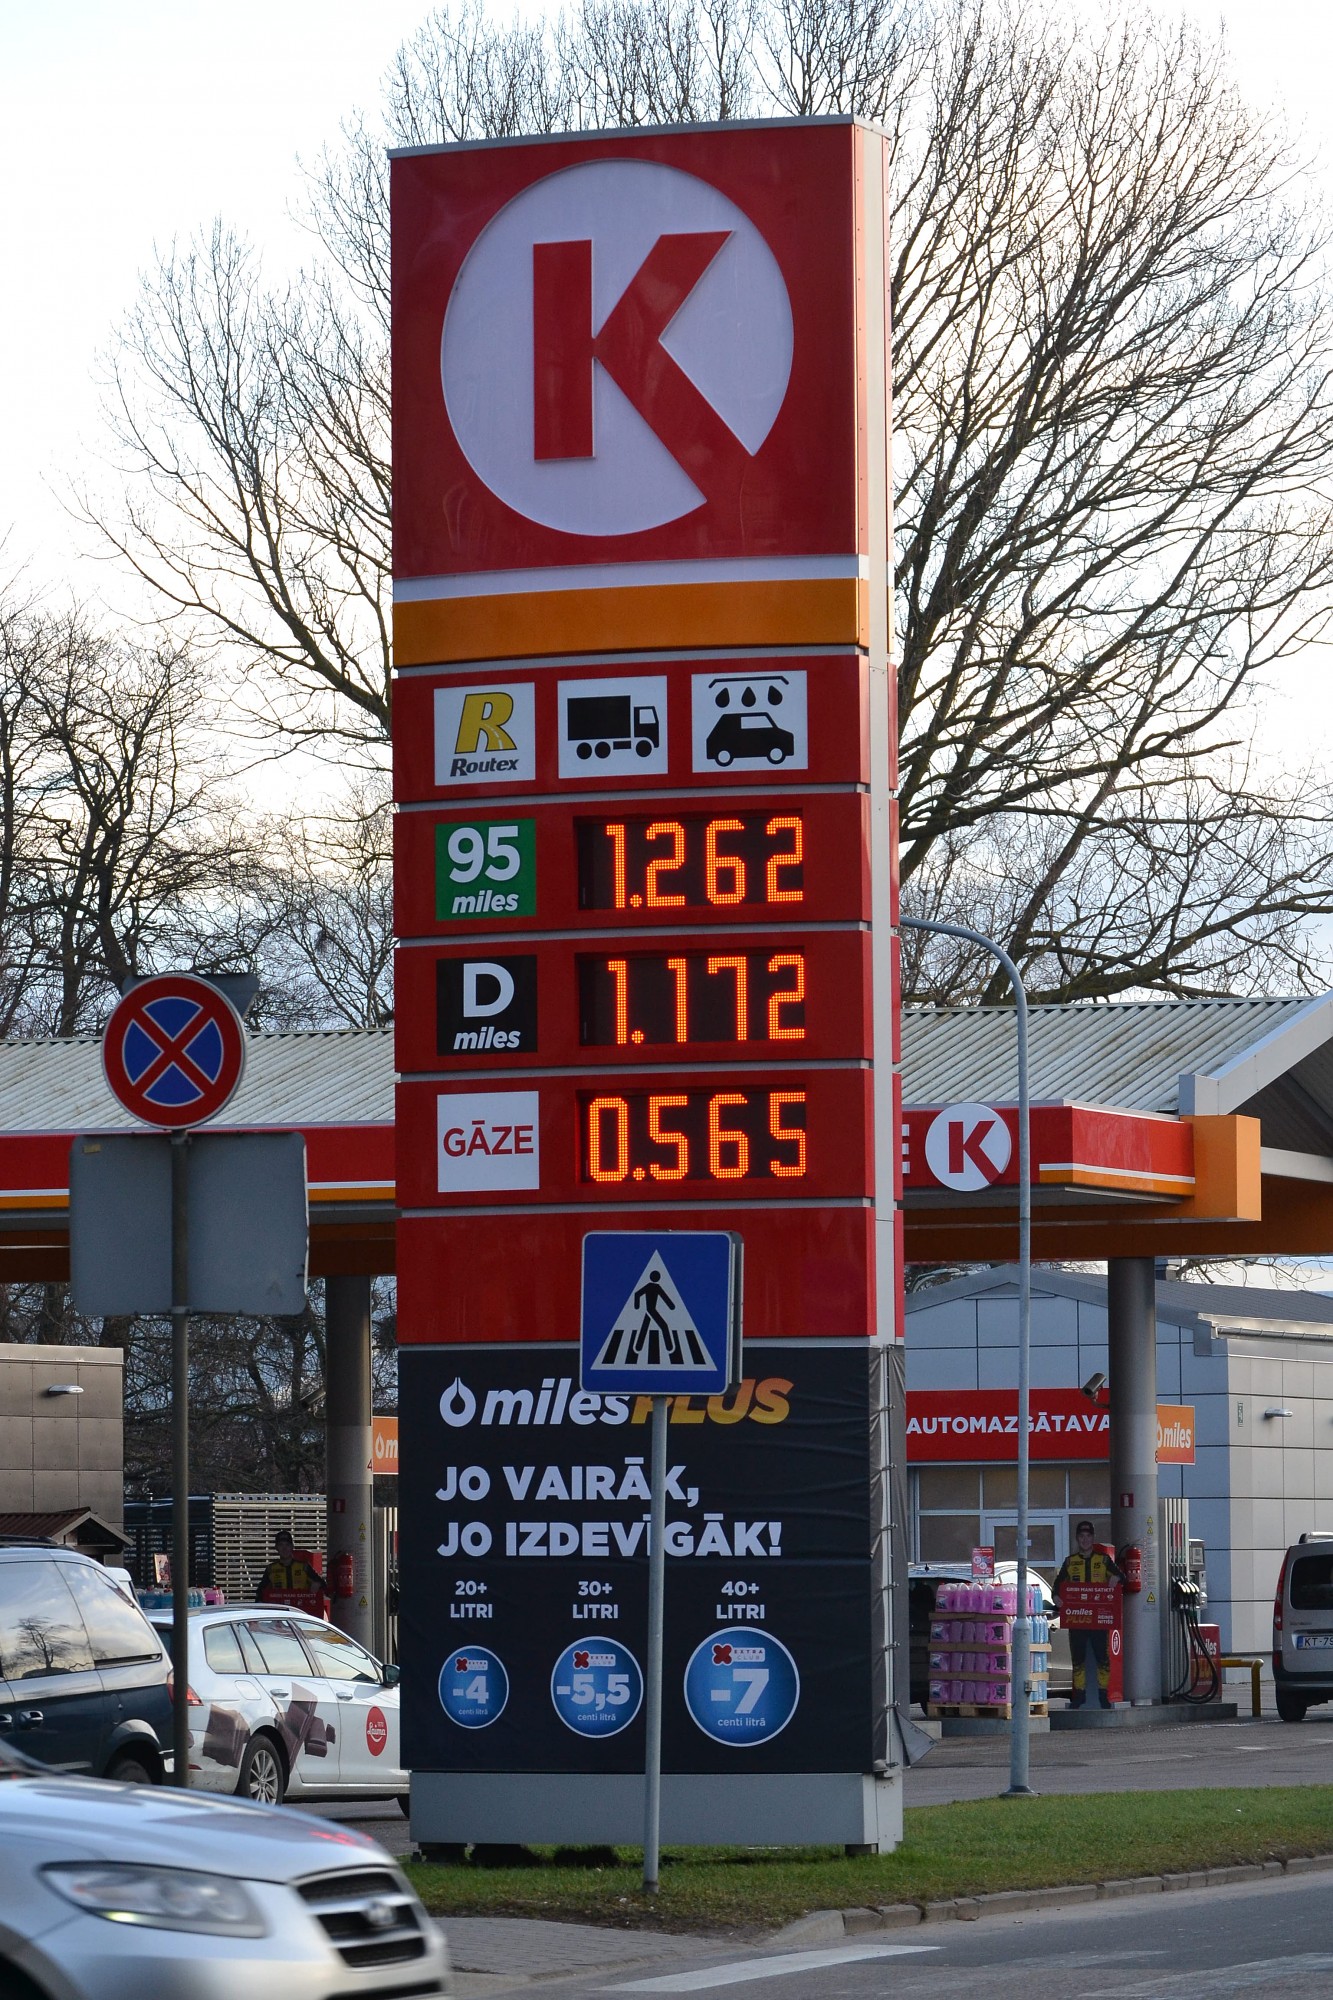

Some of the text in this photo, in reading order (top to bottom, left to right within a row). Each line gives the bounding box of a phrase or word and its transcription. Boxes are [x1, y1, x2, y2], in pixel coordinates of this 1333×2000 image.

[450, 757, 519, 777] Routex
[447, 825, 521, 883] 95
[606, 816, 804, 908] 1.262
[451, 889, 519, 914] miles
[463, 962, 515, 1018] D
[607, 954, 806, 1044] 1.172
[453, 1026, 521, 1050] miles
[443, 1120, 534, 1157] GĀZE
[588, 1091, 807, 1182] 0.565
[1163, 1422, 1191, 1448] miles
[435, 1456, 700, 1508] JO VAIRĀK,
[437, 1522, 493, 1557] JO
[455, 1580, 488, 1596] 20+
[577, 1580, 613, 1596] 30+
[720, 1580, 760, 1596] 40+
[450, 1603, 493, 1619] LITRI
[572, 1603, 619, 1619] LITRI
[716, 1603, 765, 1620] LITRI
[1071, 1608, 1093, 1616] miles
[452, 1675, 489, 1704] -4
[556, 1673, 631, 1712] -5,5
[710, 1668, 770, 1714] -7
[577, 1713, 598, 1721] centi
[717, 1717, 766, 1727] centi litrā
